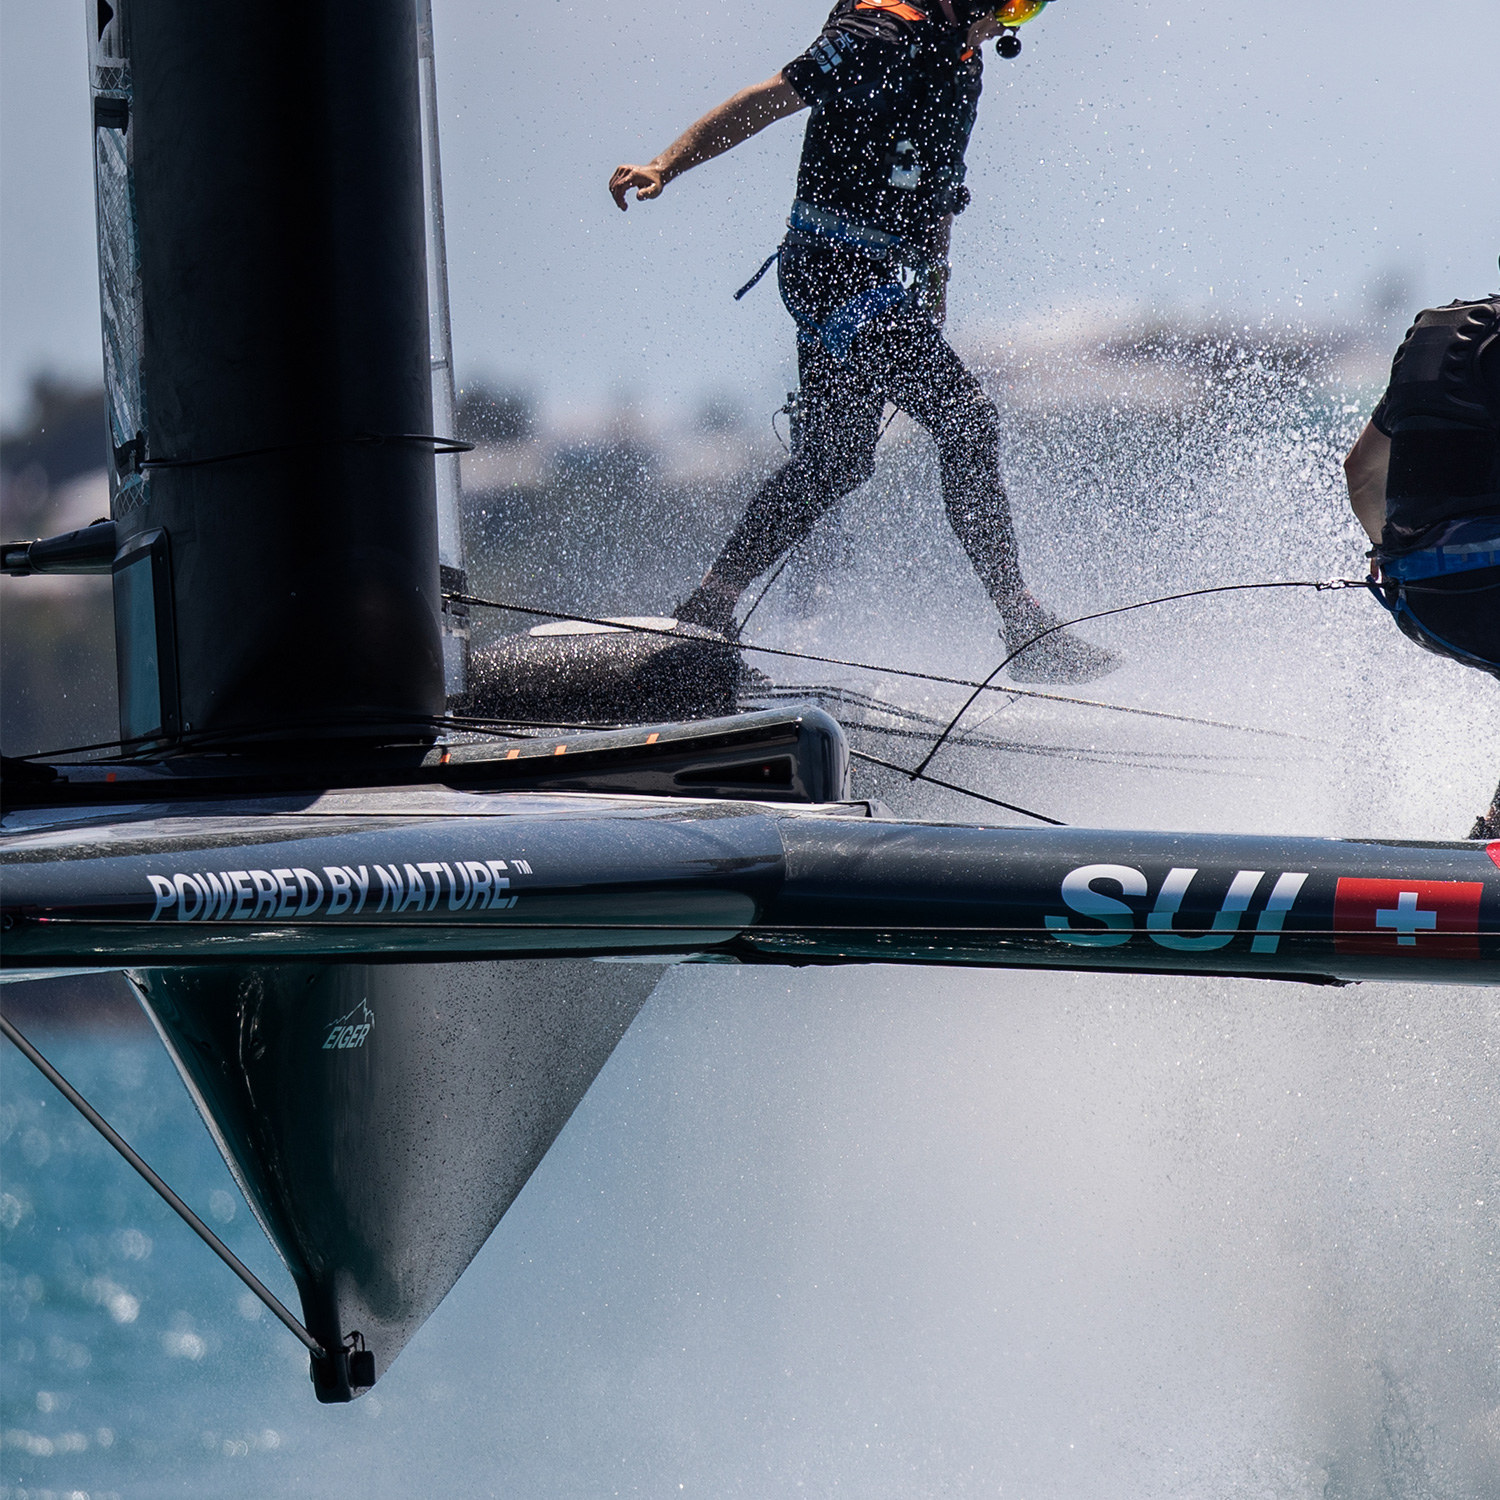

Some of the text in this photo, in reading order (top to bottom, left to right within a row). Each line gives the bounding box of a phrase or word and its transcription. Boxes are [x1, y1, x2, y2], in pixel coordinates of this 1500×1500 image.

[146, 868, 325, 921] POWERED
[323, 865, 369, 916] BY
[1043, 863, 1309, 954] SUI
[322, 1023, 370, 1050] EIGER
